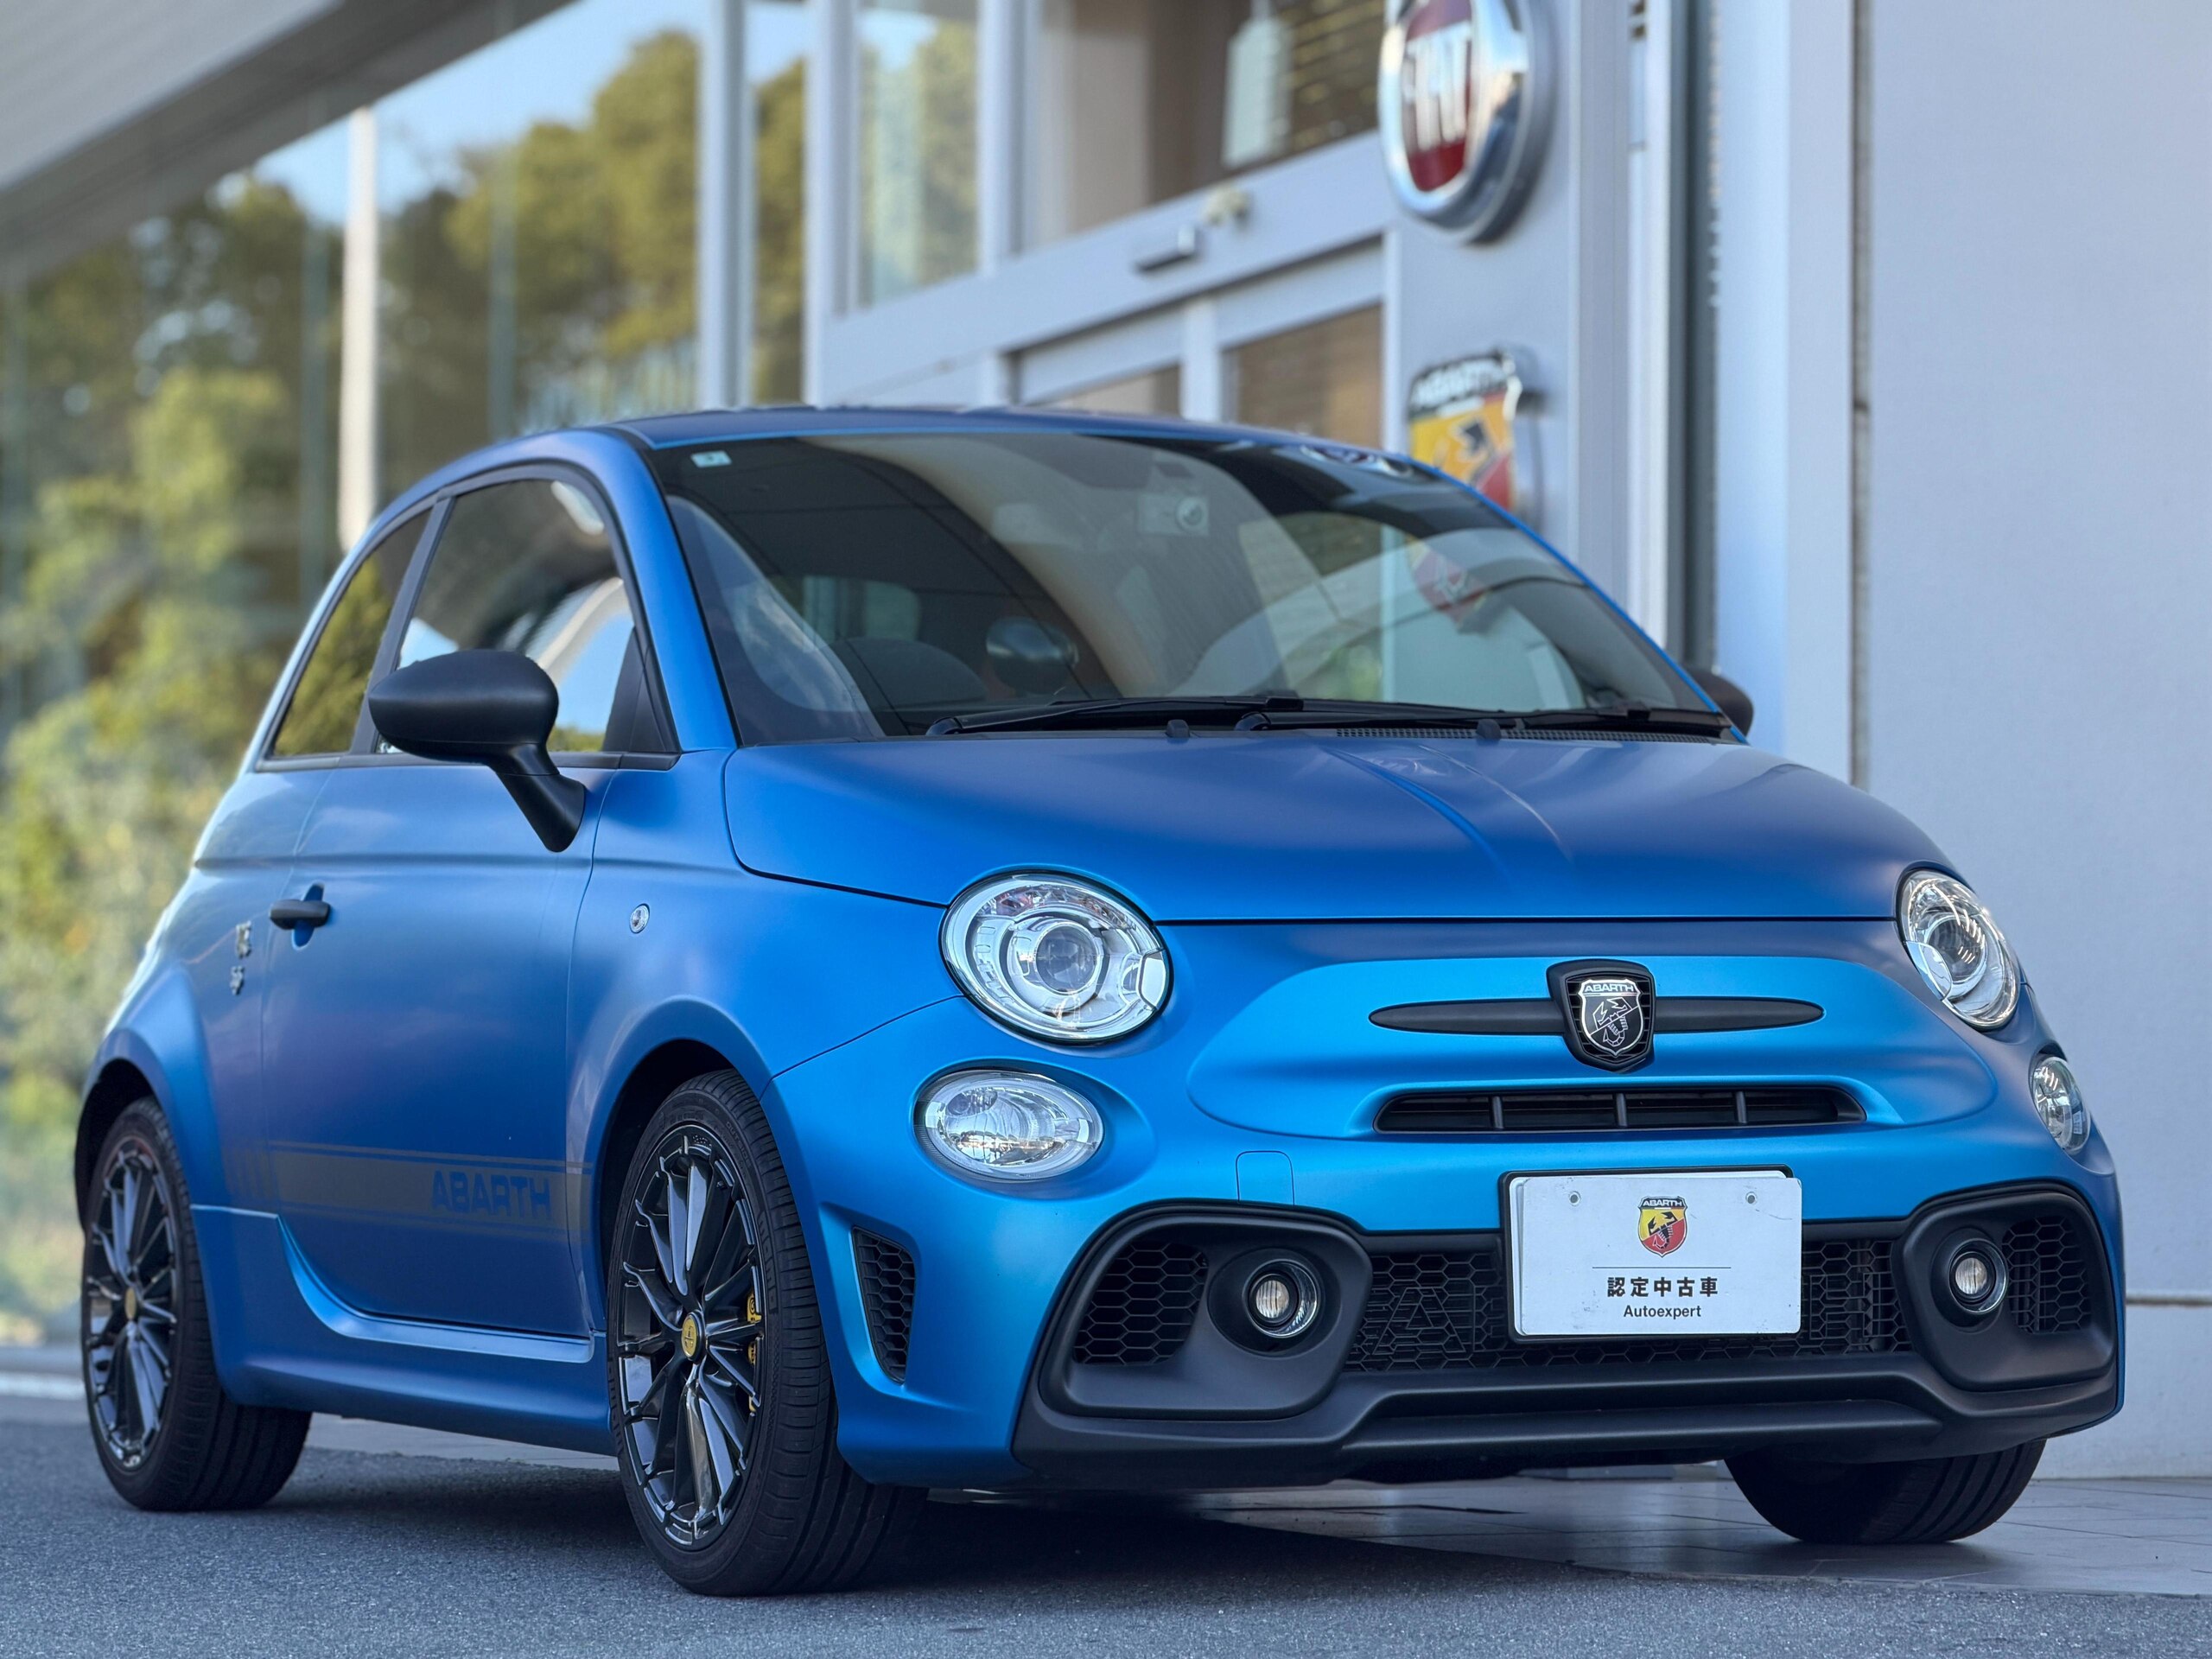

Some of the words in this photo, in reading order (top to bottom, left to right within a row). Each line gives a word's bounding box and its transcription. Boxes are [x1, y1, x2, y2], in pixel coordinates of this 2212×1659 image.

[1584, 983, 1634, 992] ABARTH
[433, 1170, 551, 1220] ABARTH
[1607, 1276, 1718, 1297] 認定中古車
[1624, 1305, 1701, 1320] Autoexpert
